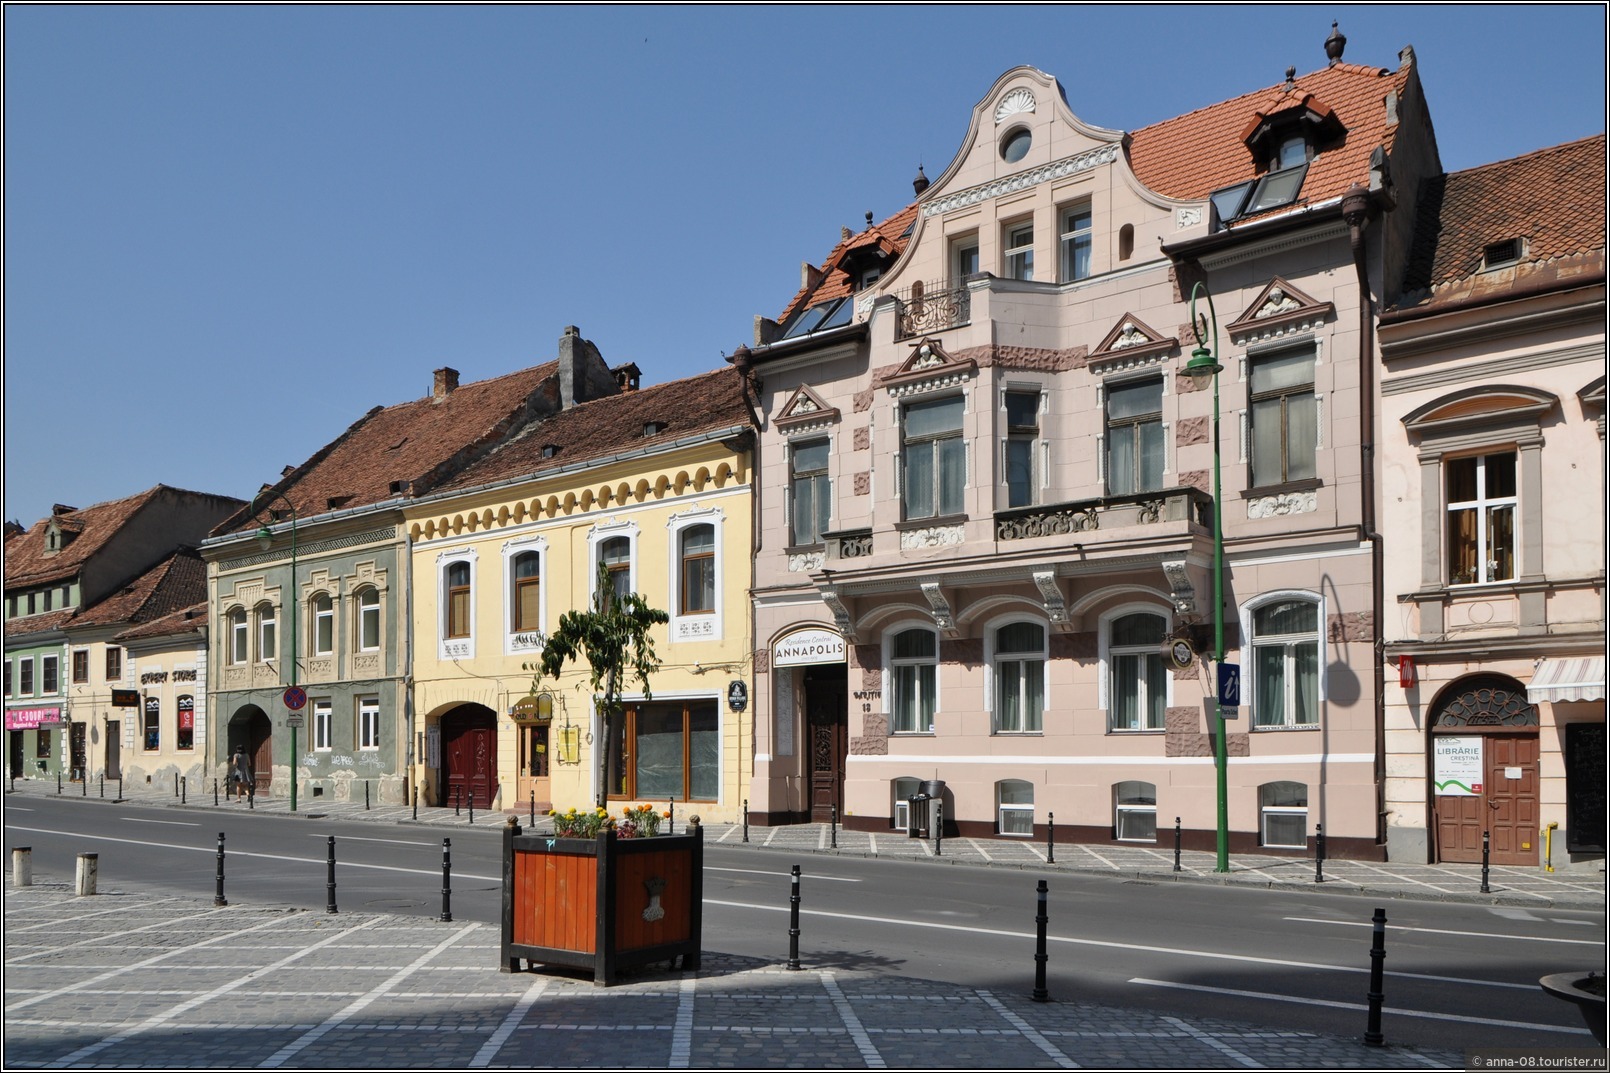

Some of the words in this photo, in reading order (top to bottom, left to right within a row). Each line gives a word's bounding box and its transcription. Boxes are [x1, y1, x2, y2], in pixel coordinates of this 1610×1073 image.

[785, 636, 811, 646] Residence
[811, 633, 832, 644] Central
[776, 644, 842, 658] ANNAPOLIS
[141, 672, 168, 684] EXPERT
[172, 670, 197, 682] STORE
[1437, 747, 1479, 755] LIBRĂRIE
